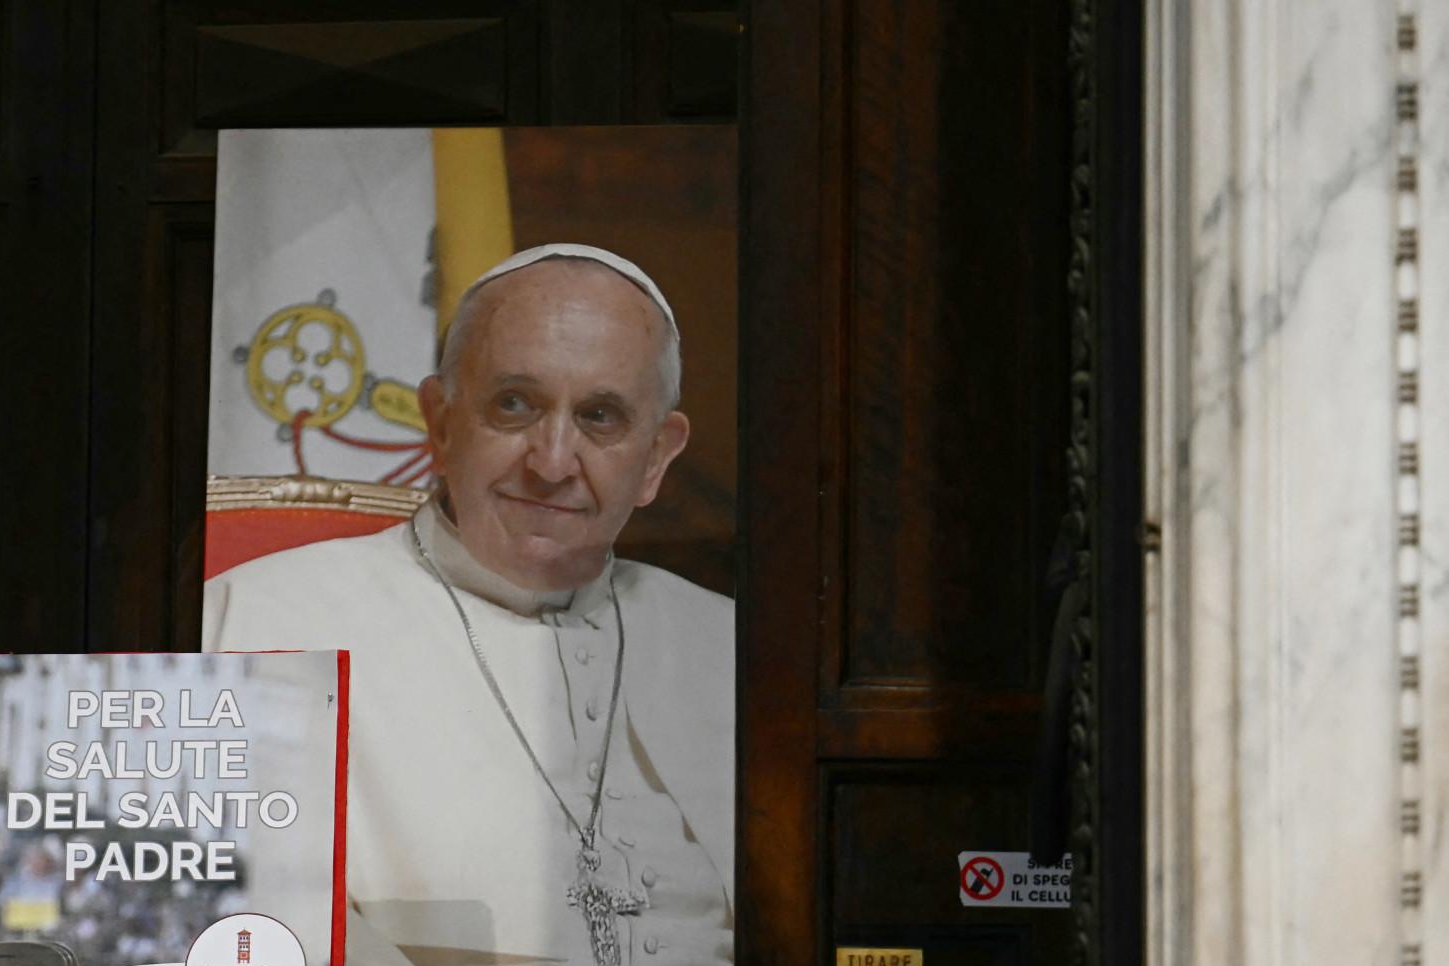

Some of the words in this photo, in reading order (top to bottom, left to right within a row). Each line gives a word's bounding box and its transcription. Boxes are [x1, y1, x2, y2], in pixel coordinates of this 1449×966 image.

[67, 690, 165, 729] PER
[179, 688, 245, 728] LA
[45, 738, 248, 780] SALUTE
[7, 791, 105, 830] DEL
[118, 790, 299, 830] SANTO
[65, 840, 237, 882] PADRE
[1013, 874, 1027, 886] DI
[1011, 890, 1023, 902] IL
